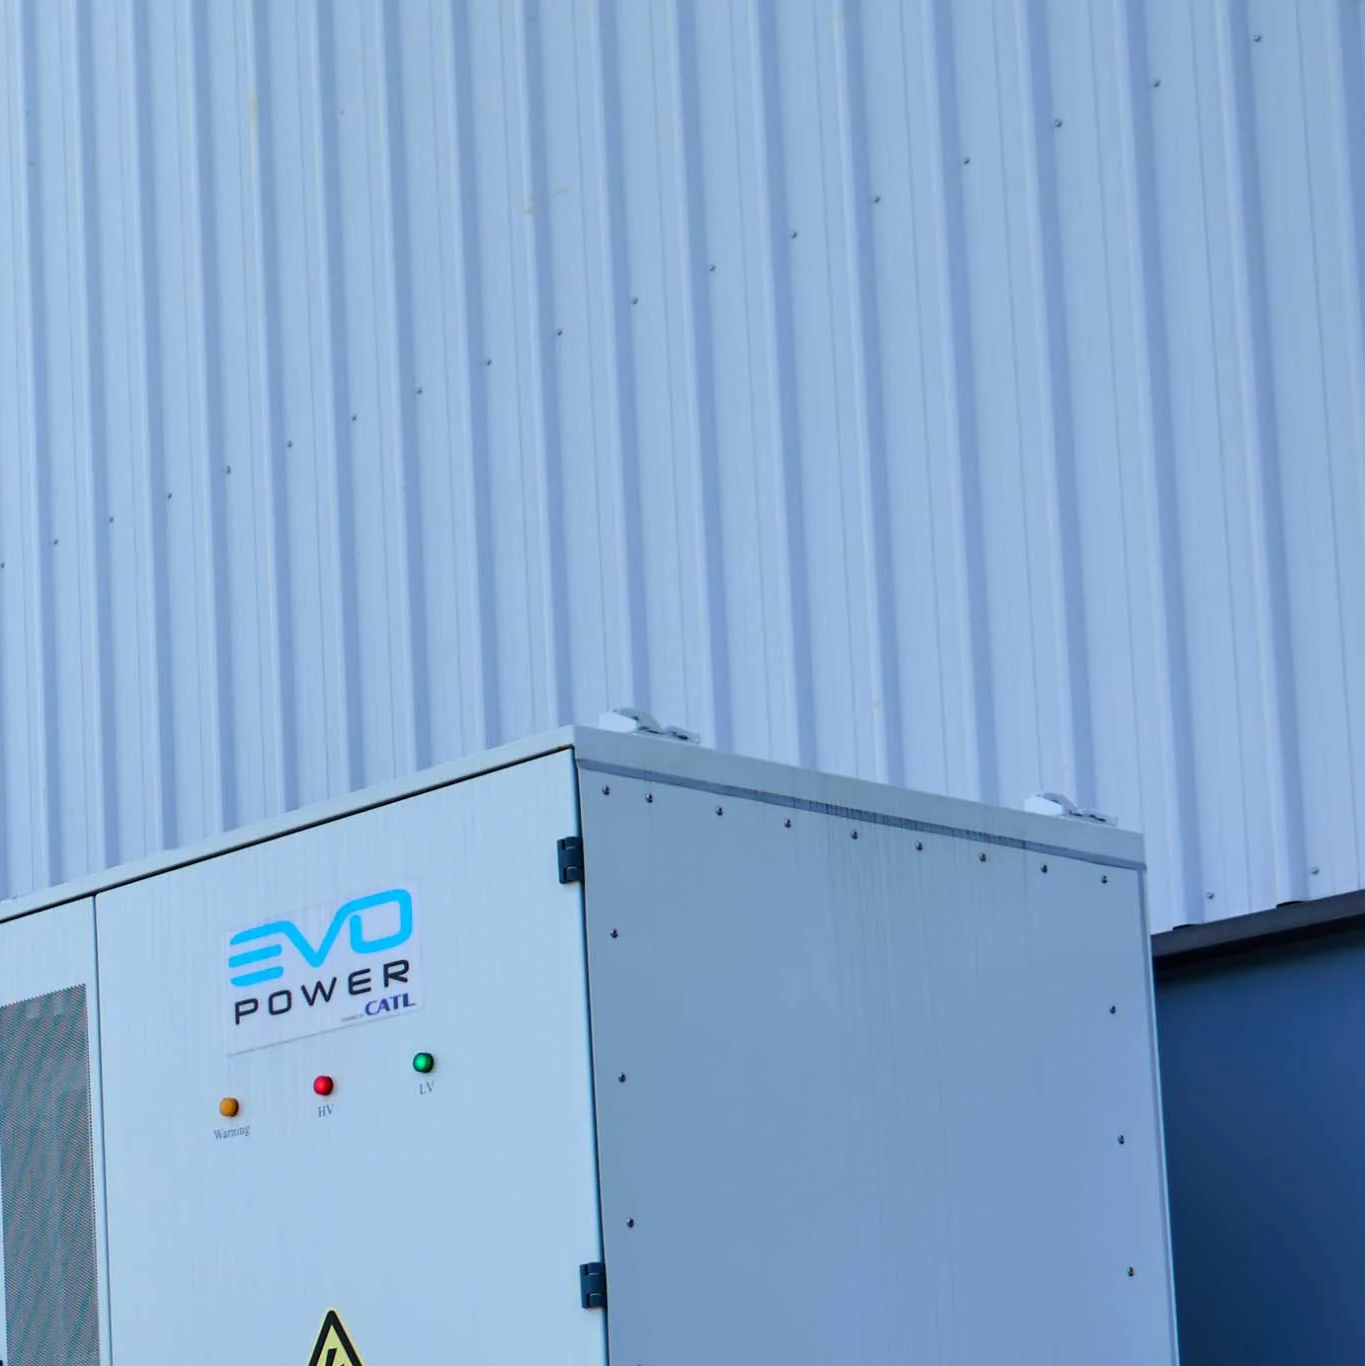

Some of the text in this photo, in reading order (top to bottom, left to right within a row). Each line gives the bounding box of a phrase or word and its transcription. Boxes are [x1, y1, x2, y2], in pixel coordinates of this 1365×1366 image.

[228, 888, 413, 987] EVO
[234, 959, 410, 1026] POWER
[364, 993, 416, 1016] CATL
[418, 1080, 434, 1096] LV
[318, 1104, 334, 1118] HV
[213, 1124, 251, 1140] Warning
